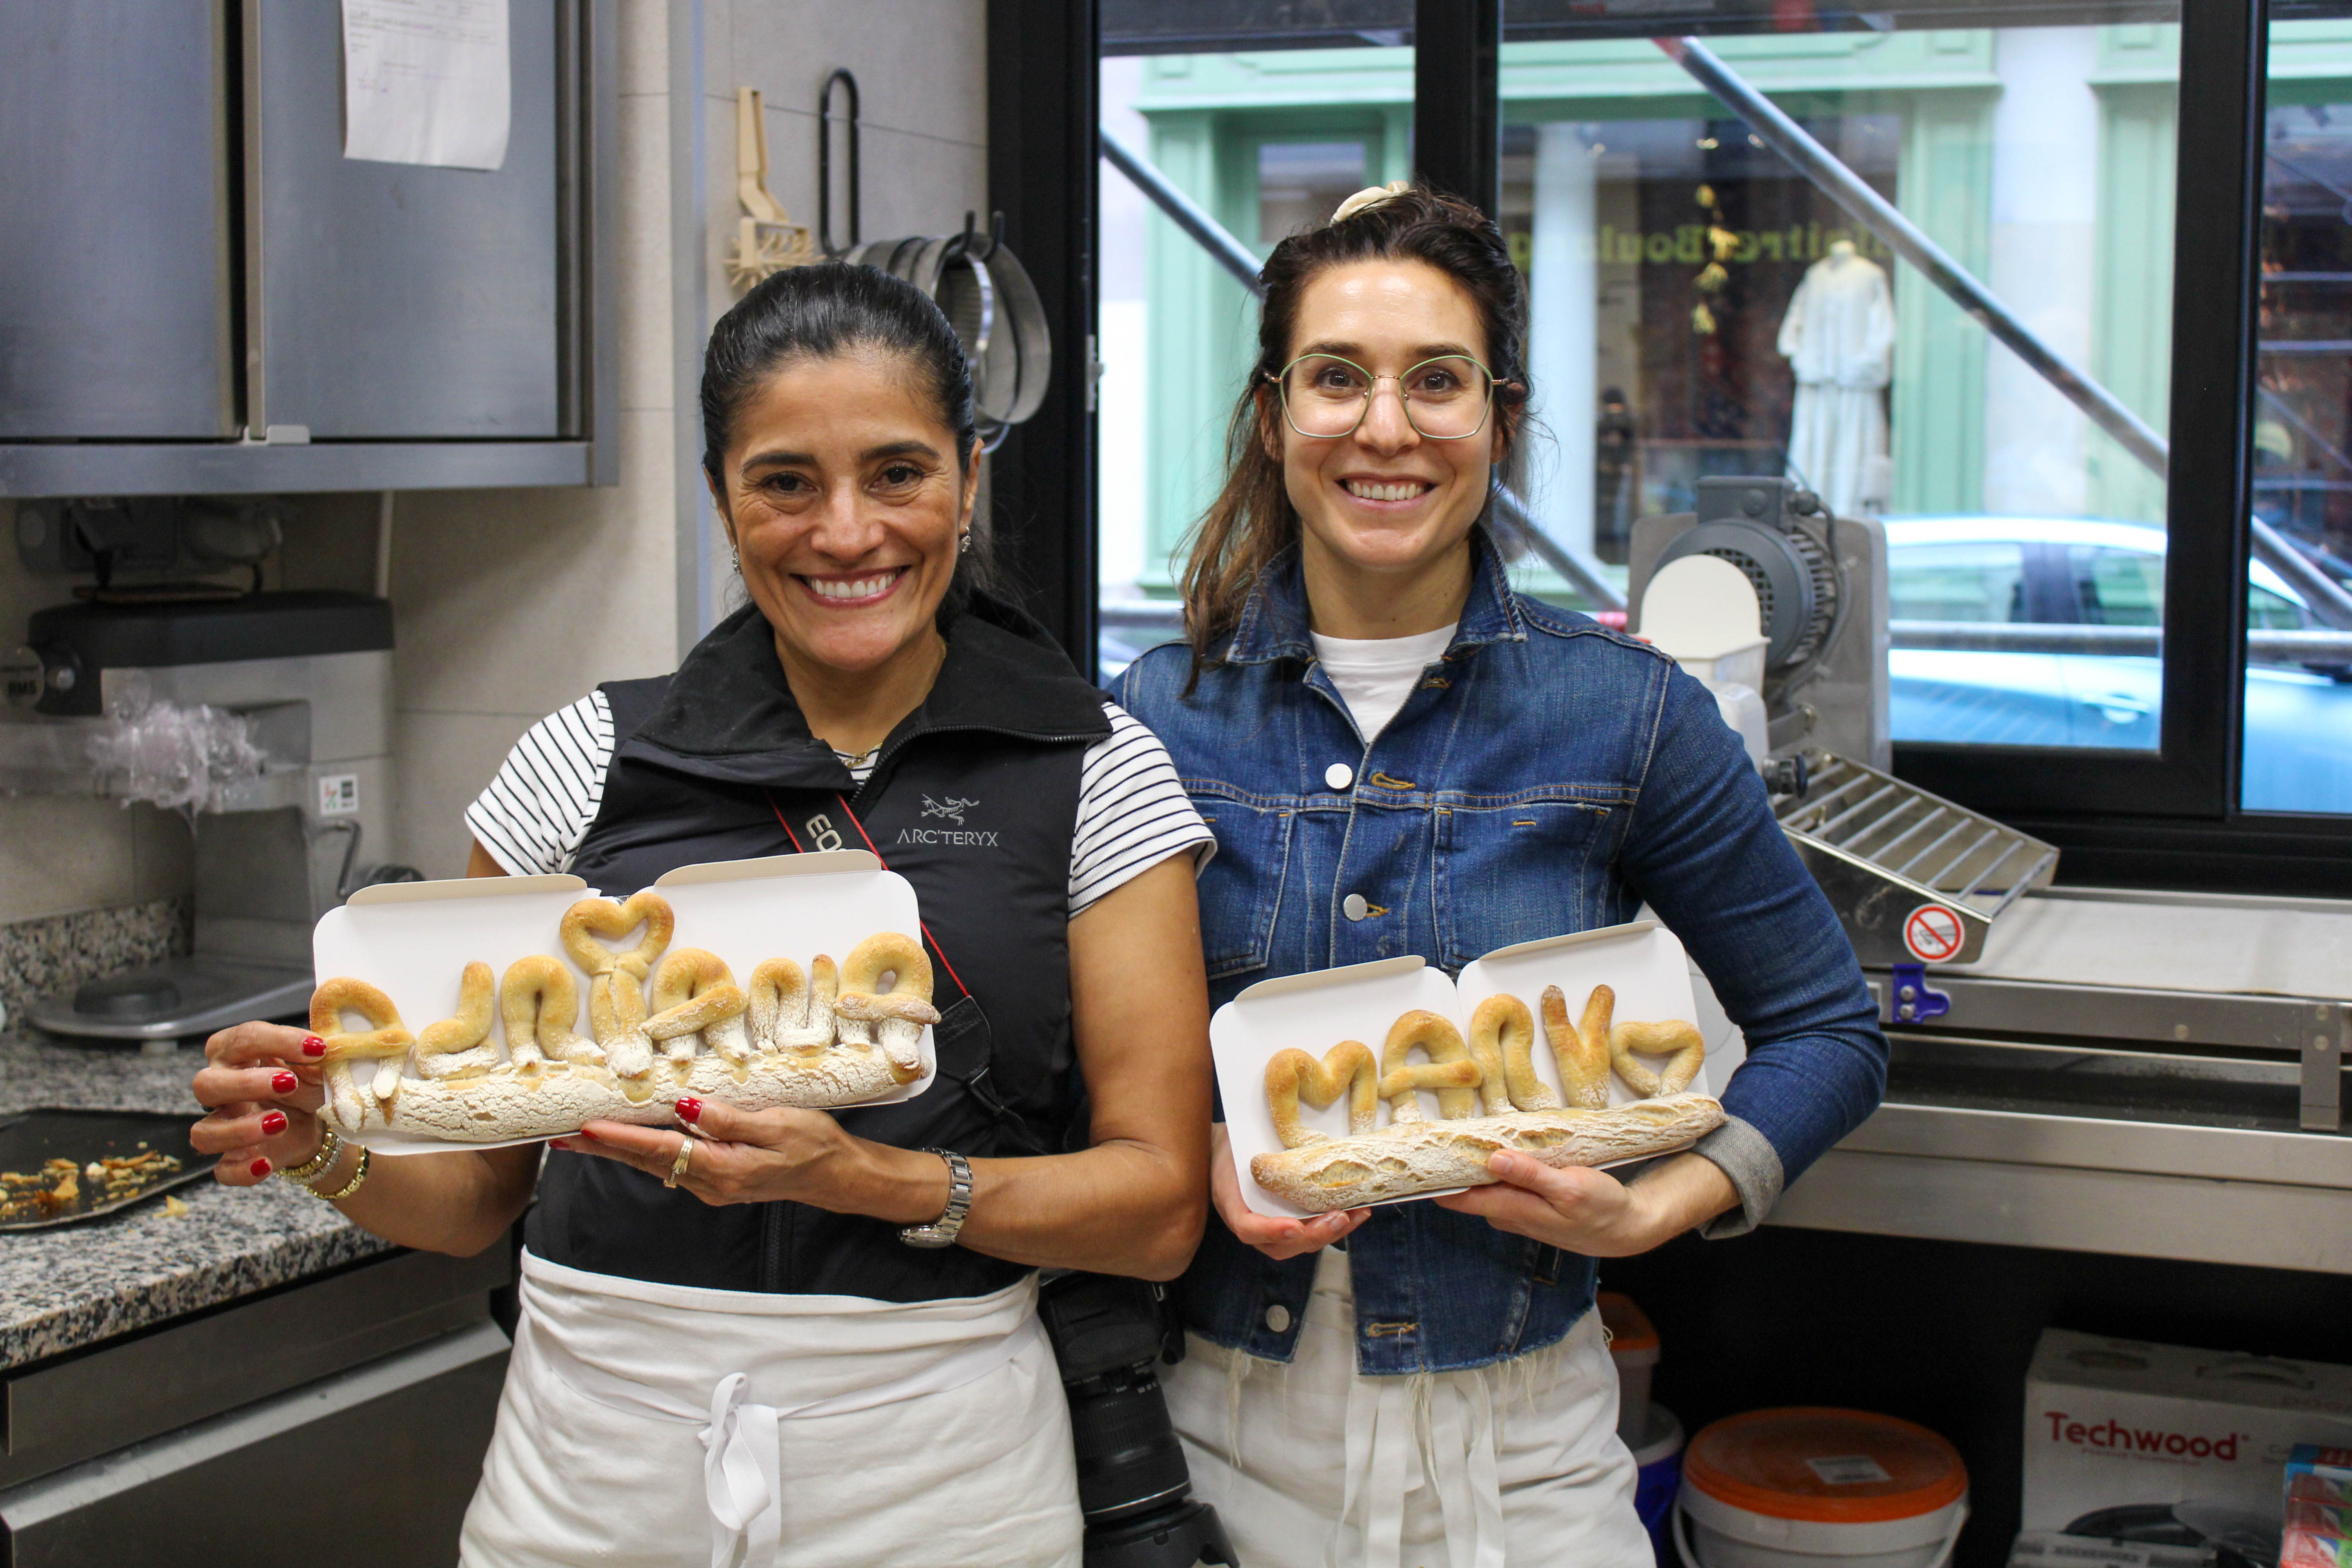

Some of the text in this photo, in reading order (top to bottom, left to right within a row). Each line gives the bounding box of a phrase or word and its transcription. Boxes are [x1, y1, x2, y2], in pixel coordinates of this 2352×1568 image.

[806, 814, 847, 852] EO
[897, 828, 999, 847] ARC'TERYX
[2044, 1411, 2238, 1461] Techwood
